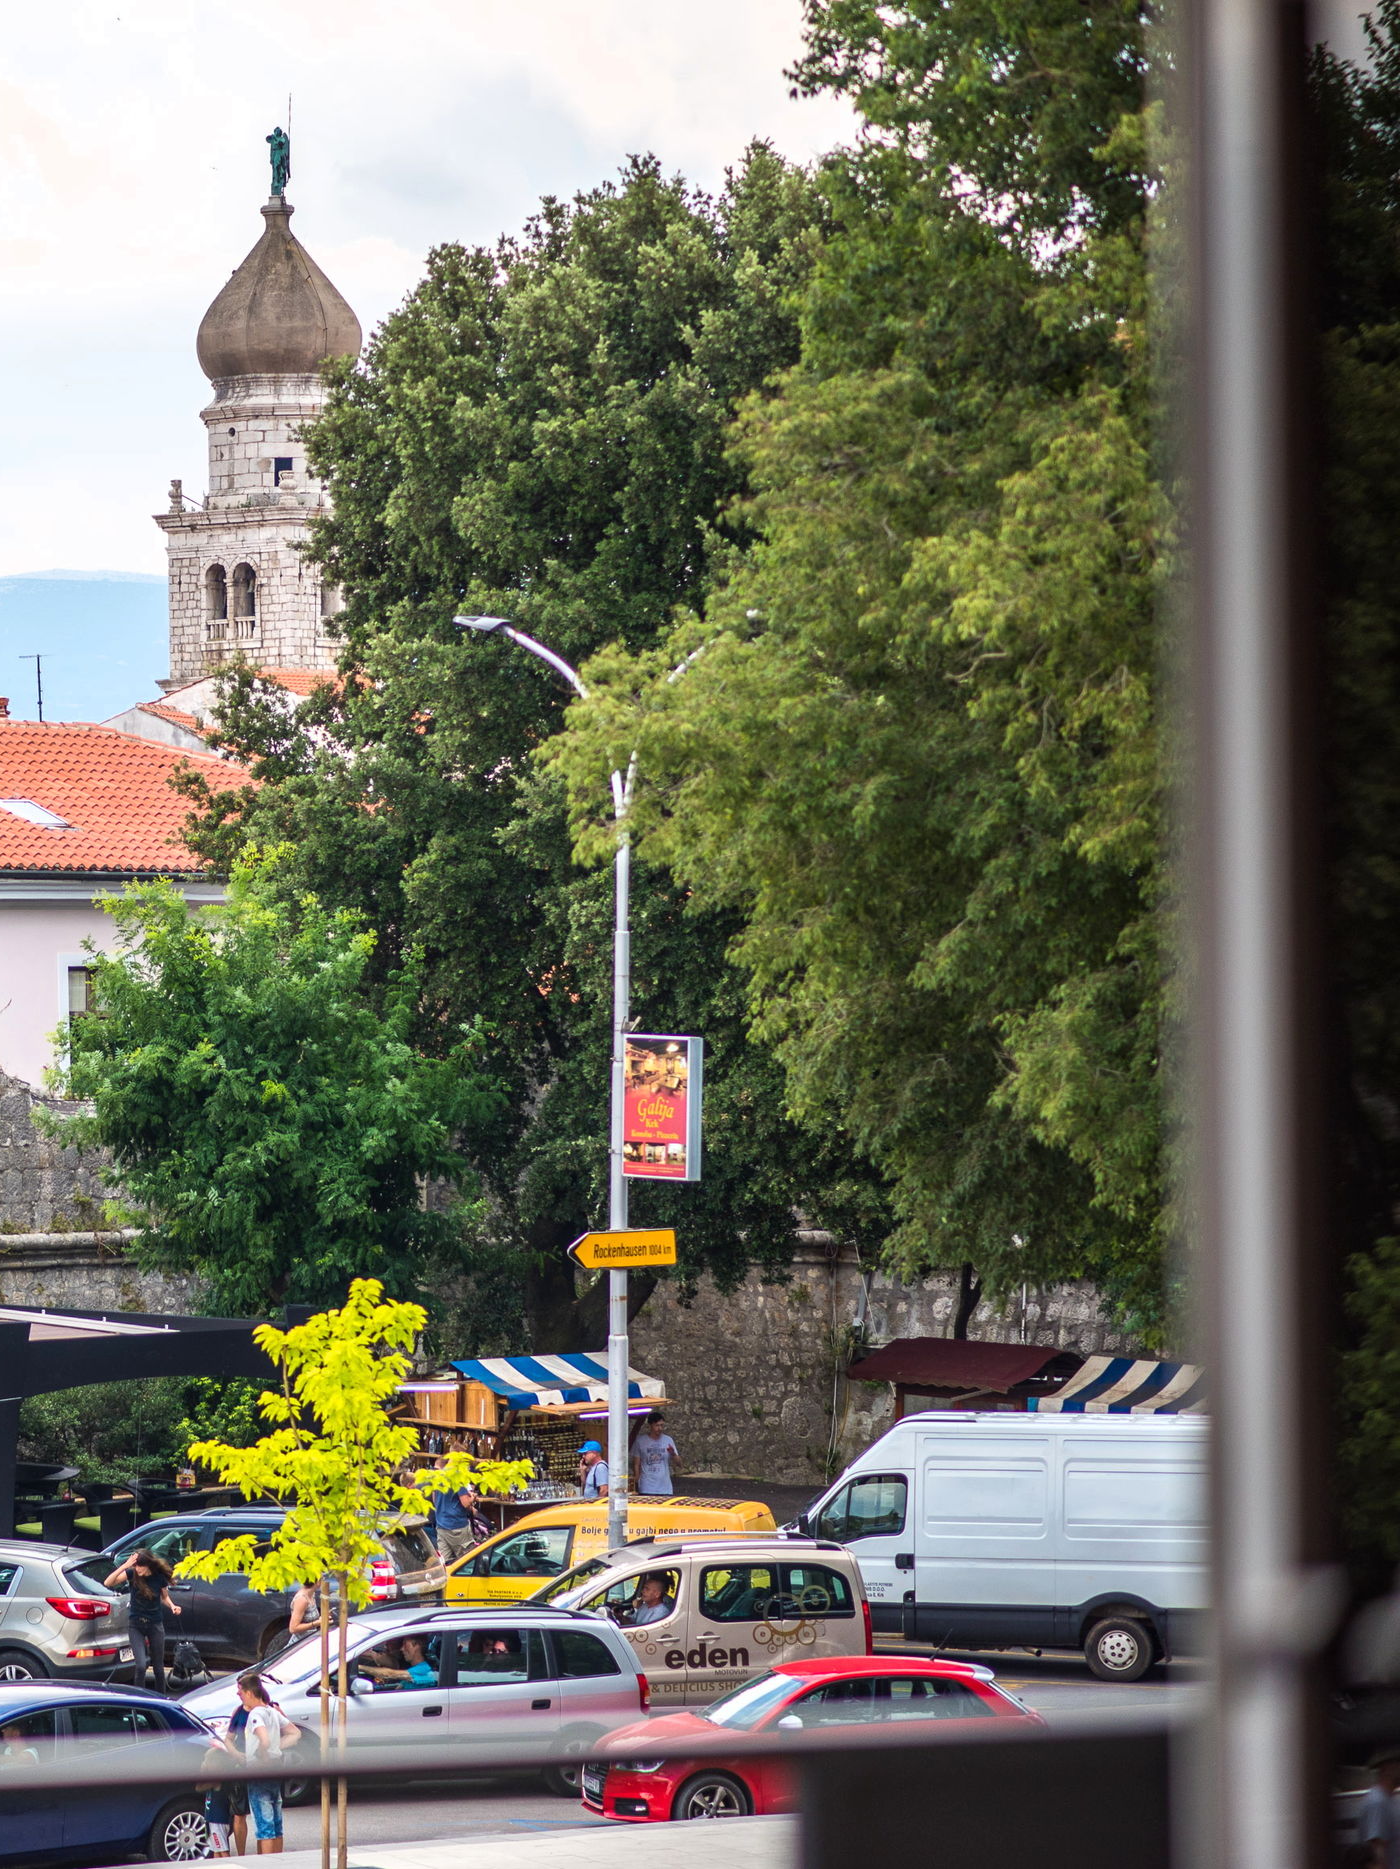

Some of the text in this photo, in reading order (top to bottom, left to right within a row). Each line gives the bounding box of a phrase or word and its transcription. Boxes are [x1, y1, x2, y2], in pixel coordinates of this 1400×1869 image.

[637, 1096, 675, 1121] Galija
[594, 1243, 672, 1259] Rockenhausen 1004 km
[581, 1526, 602, 1535] Bolje
[636, 1526, 657, 1536] gajbi
[665, 1643, 749, 1669] eden
[651, 1684, 660, 1693] &
[664, 1681, 716, 1693] DELICIUS
